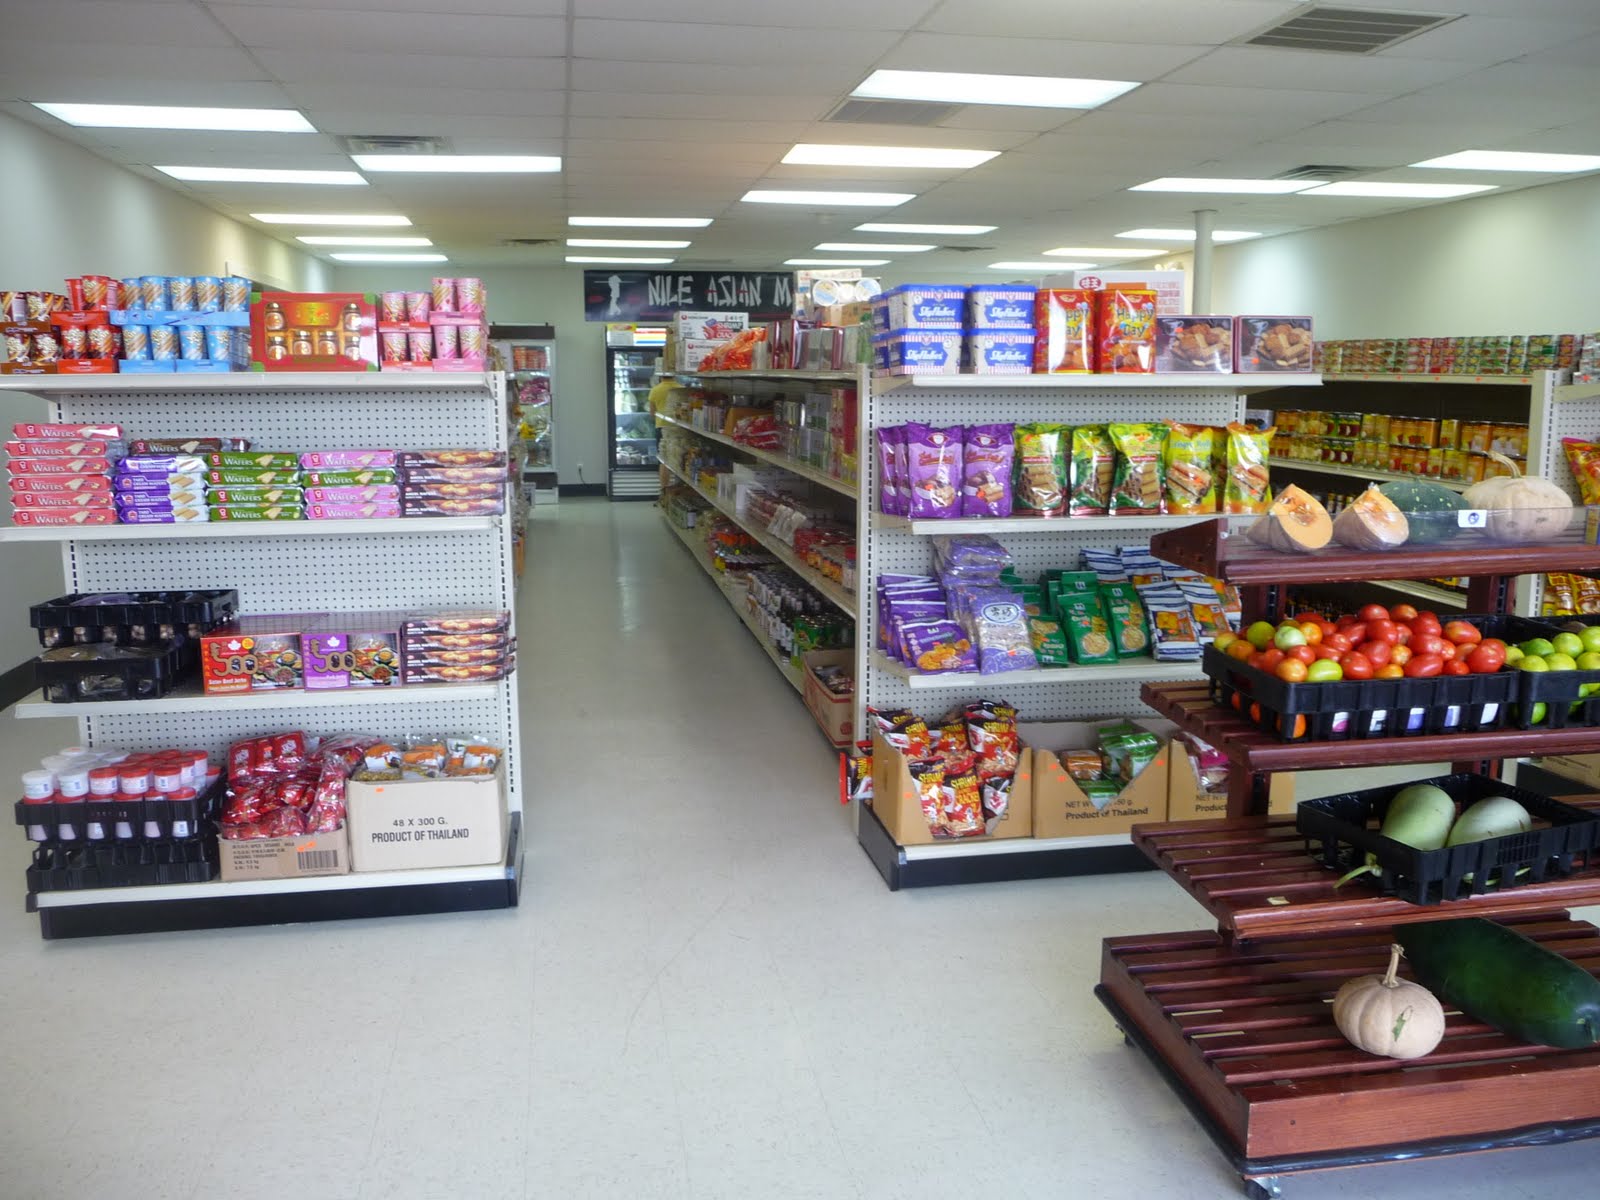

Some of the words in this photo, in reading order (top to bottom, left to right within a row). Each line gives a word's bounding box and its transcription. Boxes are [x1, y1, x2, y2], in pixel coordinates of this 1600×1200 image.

[648, 275, 694, 307] NILE
[707, 275, 762, 307] ASIAN
[40, 429, 76, 437] WAFERS
[32, 447, 65, 455] WAFERS
[224, 457, 254, 465] WAFERS
[32, 464, 66, 472] WAFERS
[224, 475, 255, 483] WAFERS
[30, 482, 64, 490] WAFERS
[231, 493, 262, 502] WAFERS
[37, 498, 71, 506] WAFERS
[231, 511, 262, 519] WAFERS
[34, 515, 68, 524] WAFERS
[1065, 809, 1097, 820] Product
[1112, 807, 1149, 816] Thailand
[393, 819, 405, 827] 48
[418, 817, 435, 826] 300
[371, 831, 412, 843] PRODUCT
[414, 830, 426, 841] OF
[427, 828, 470, 840] THAILAND
